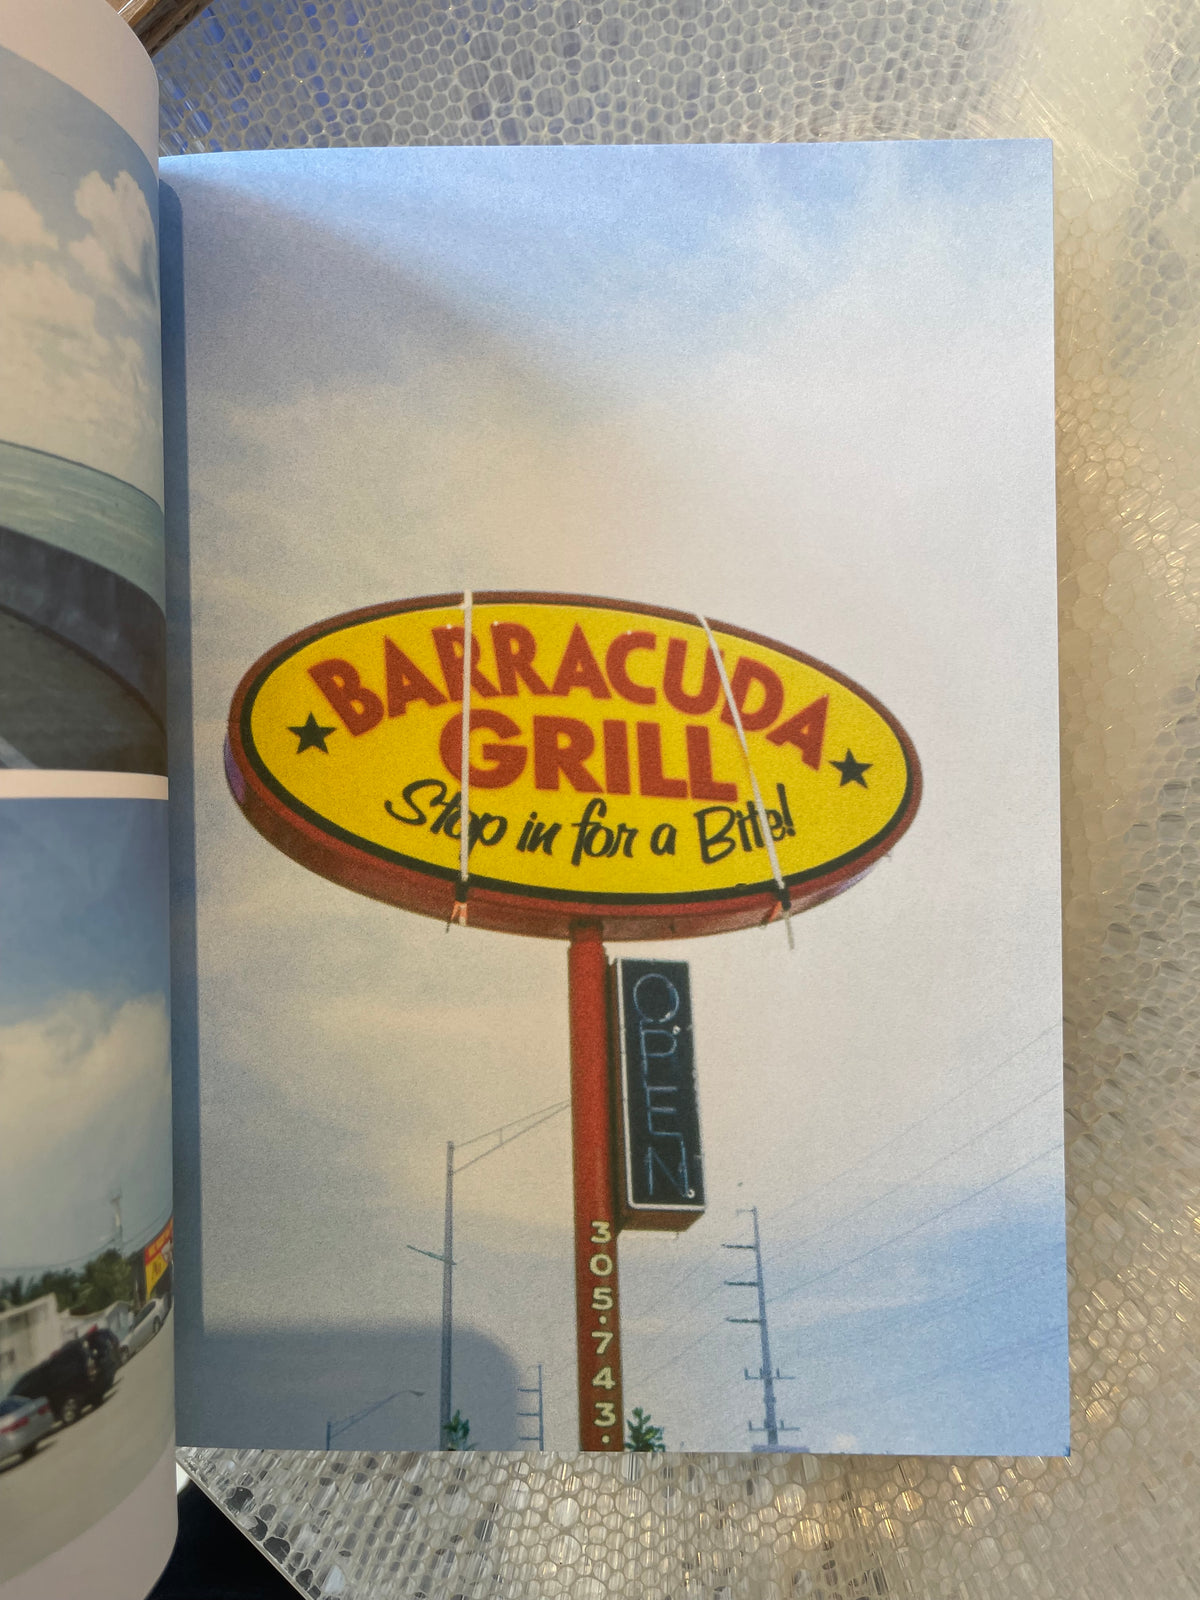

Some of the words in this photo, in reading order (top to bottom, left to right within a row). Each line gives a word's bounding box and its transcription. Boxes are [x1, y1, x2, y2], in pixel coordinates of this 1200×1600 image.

[307, 622, 830, 771] BARRACUDA
[438, 708, 738, 802] GRILL
[384, 778, 508, 861] Stop
[516, 811, 562, 856] in
[571, 797, 639, 867] for
[650, 822, 678, 857] a
[692, 782, 797, 865] Bite!
[632, 972, 691, 1197] OPEN
